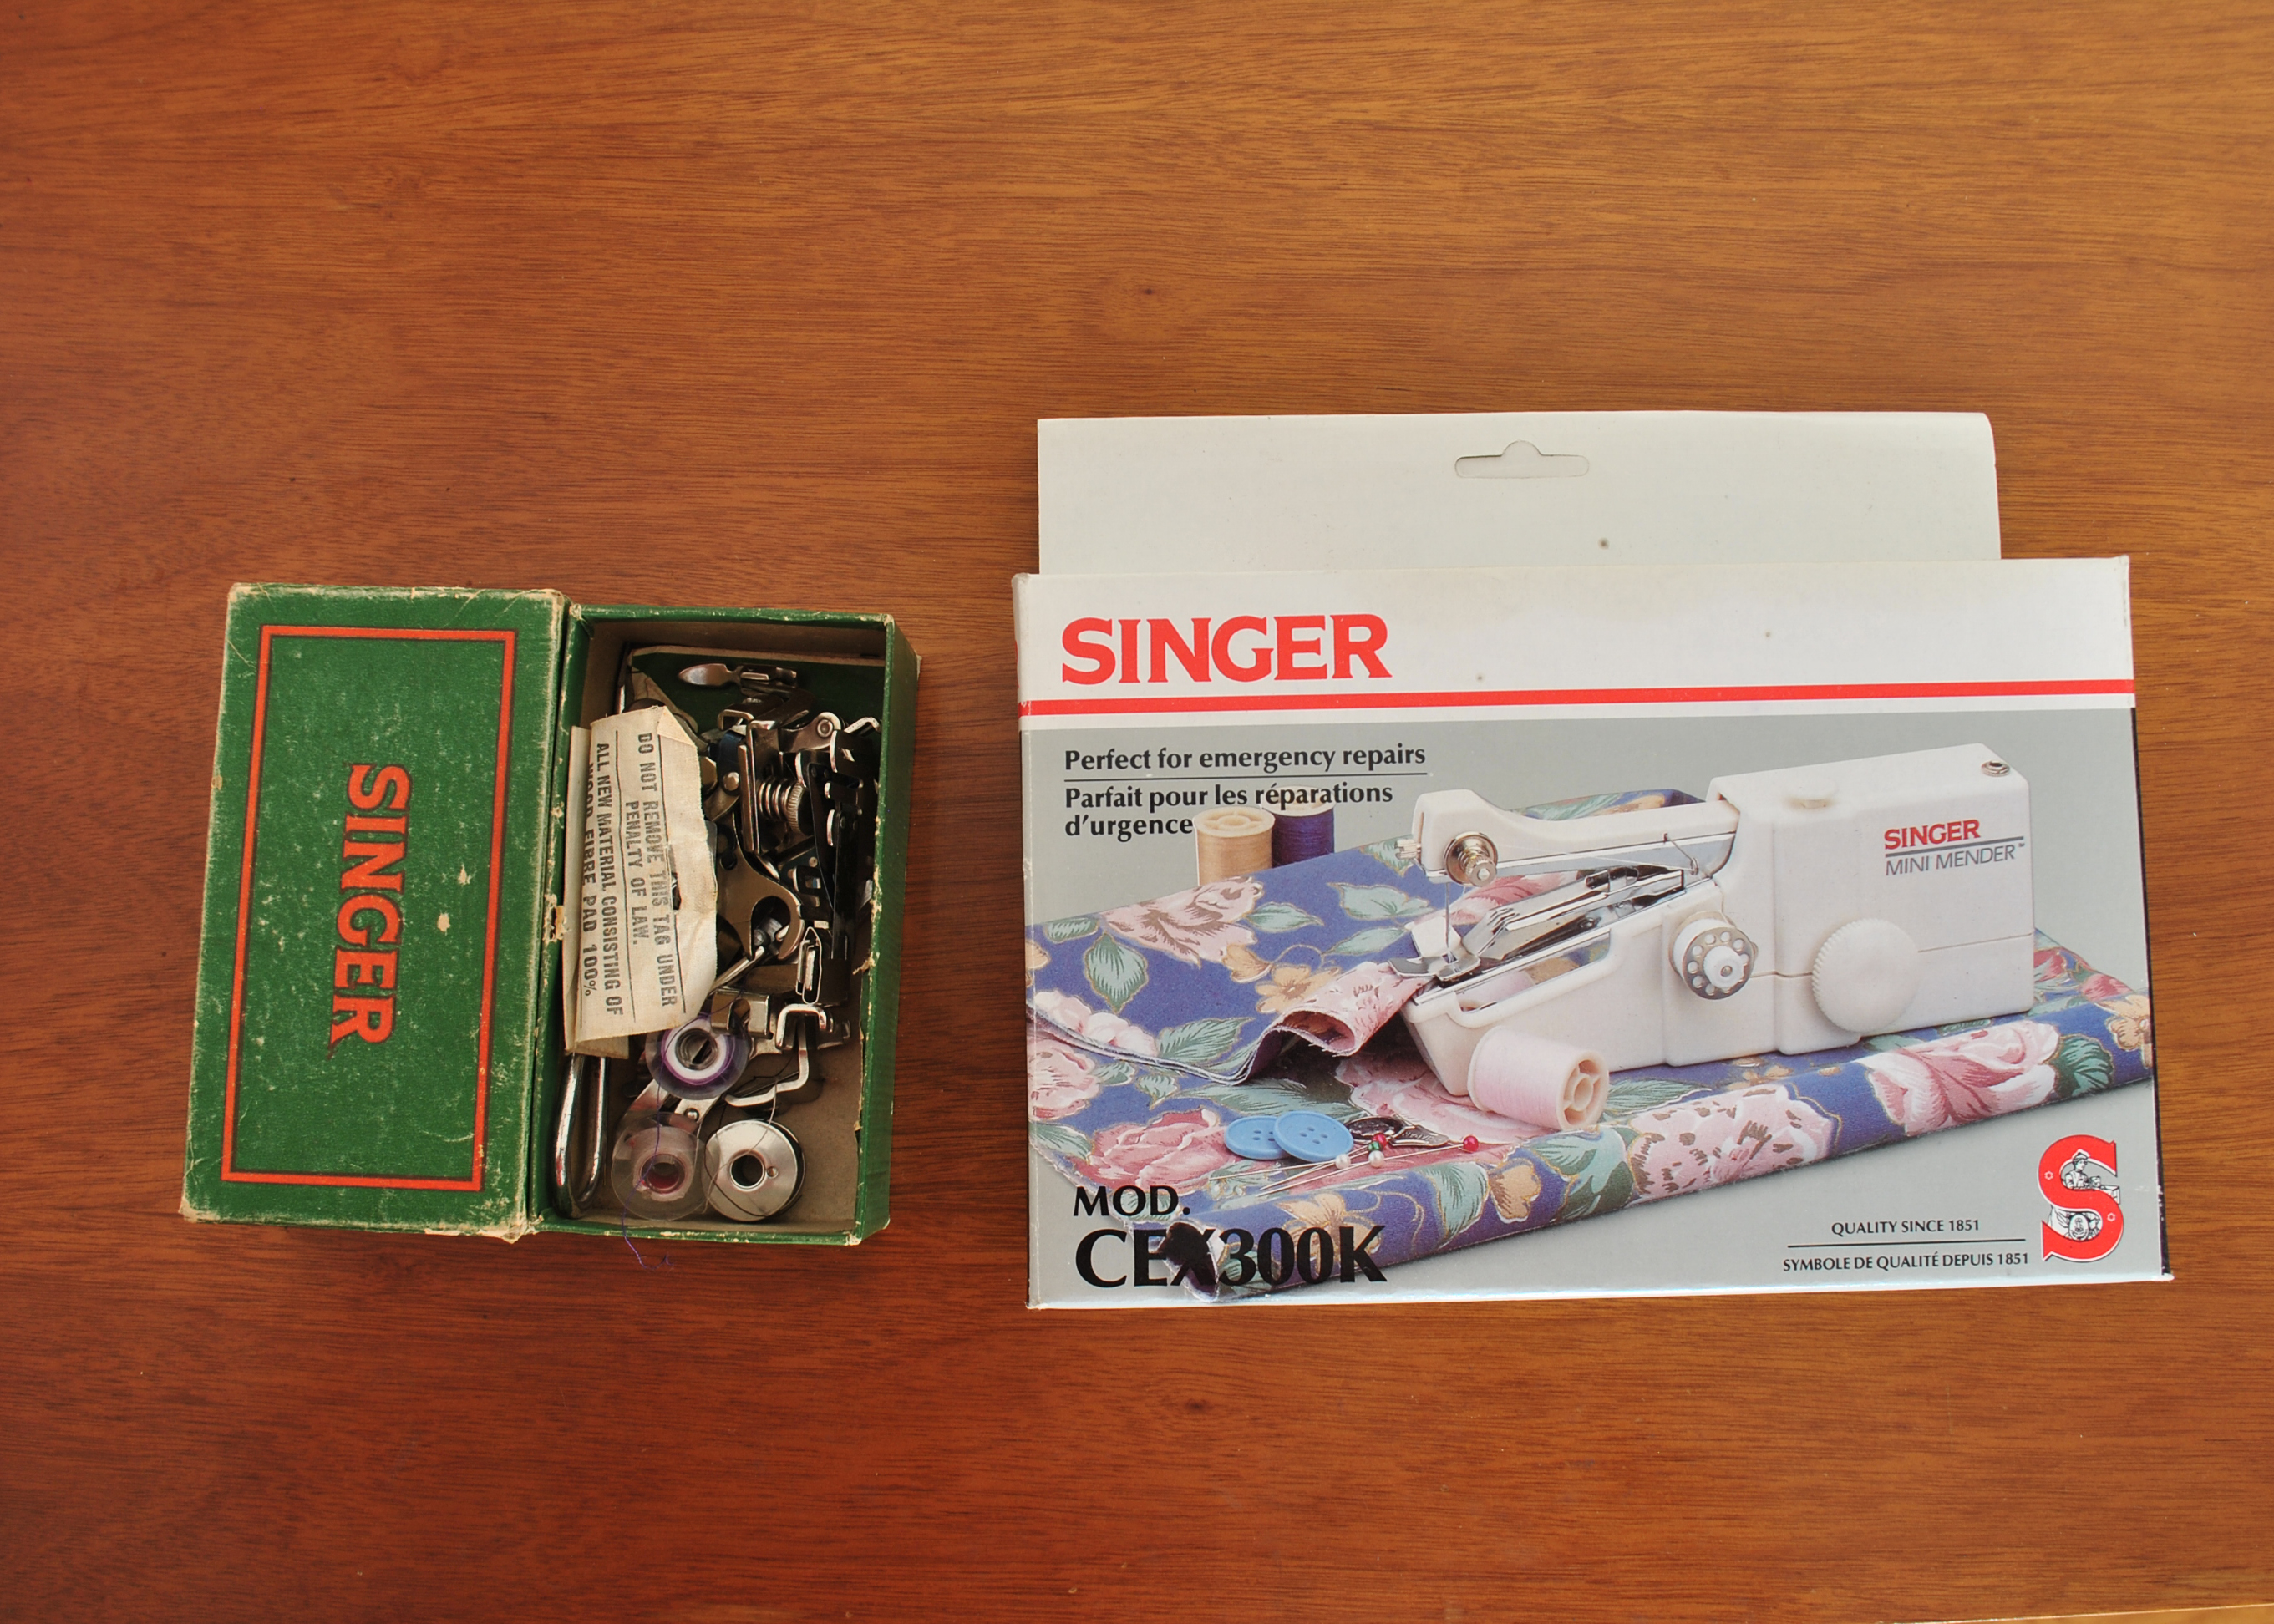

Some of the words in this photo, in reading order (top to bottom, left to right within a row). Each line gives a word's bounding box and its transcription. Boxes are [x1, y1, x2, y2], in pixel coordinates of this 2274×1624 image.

[1062, 613, 1393, 685] SINGER
[596, 743, 610, 772] ALL
[637, 733, 653, 754] DO
[1065, 749, 1150, 770] Perfect
[1158, 746, 1191, 768] for
[1199, 749, 1336, 773] emergency
[1343, 743, 1426, 770] repairs
[596, 775, 612, 808] NEW
[639, 762, 658, 793] NOT
[1065, 786, 1143, 808] Parfait
[1150, 789, 1208, 812] pour
[1215, 784, 1248, 805] les
[1255, 781, 1393, 810] réparations
[624, 800, 644, 868] PENALTY
[642, 801, 667, 864] REMOVE
[1065, 814, 1193, 842] d'urgence
[1884, 819, 1981, 850] SINGER
[596, 813, 617, 892] MATERIAL
[1886, 855, 1929, 876] MINI
[629, 876, 646, 899] OF
[649, 870, 671, 907] THIS
[328, 762, 413, 1051] SINGER
[582, 894, 598, 933] PAD
[631, 906, 648, 946] LAW.
[652, 914, 671, 946] TAG
[601, 896, 621, 991] CONSISTING
[582, 944, 598, 997] 100%
[656, 954, 678, 1007] UNDER
[605, 996, 623, 1015] OF
[1073, 1185, 1191, 1217] MOD.
[1831, 1221, 1897, 1236] QUALITY
[1901, 1220, 1944, 1233] SINCE
[1948, 1219, 1980, 1231] 1851
[1783, 1255, 1850, 1272] SYMBOLE
[1855, 1256, 1873, 1270] DE
[1876, 1251, 1940, 1271] QUALITÉ
[1942, 1252, 1994, 1267] DEPUIS
[1997, 1252, 2029, 1266] 1851
